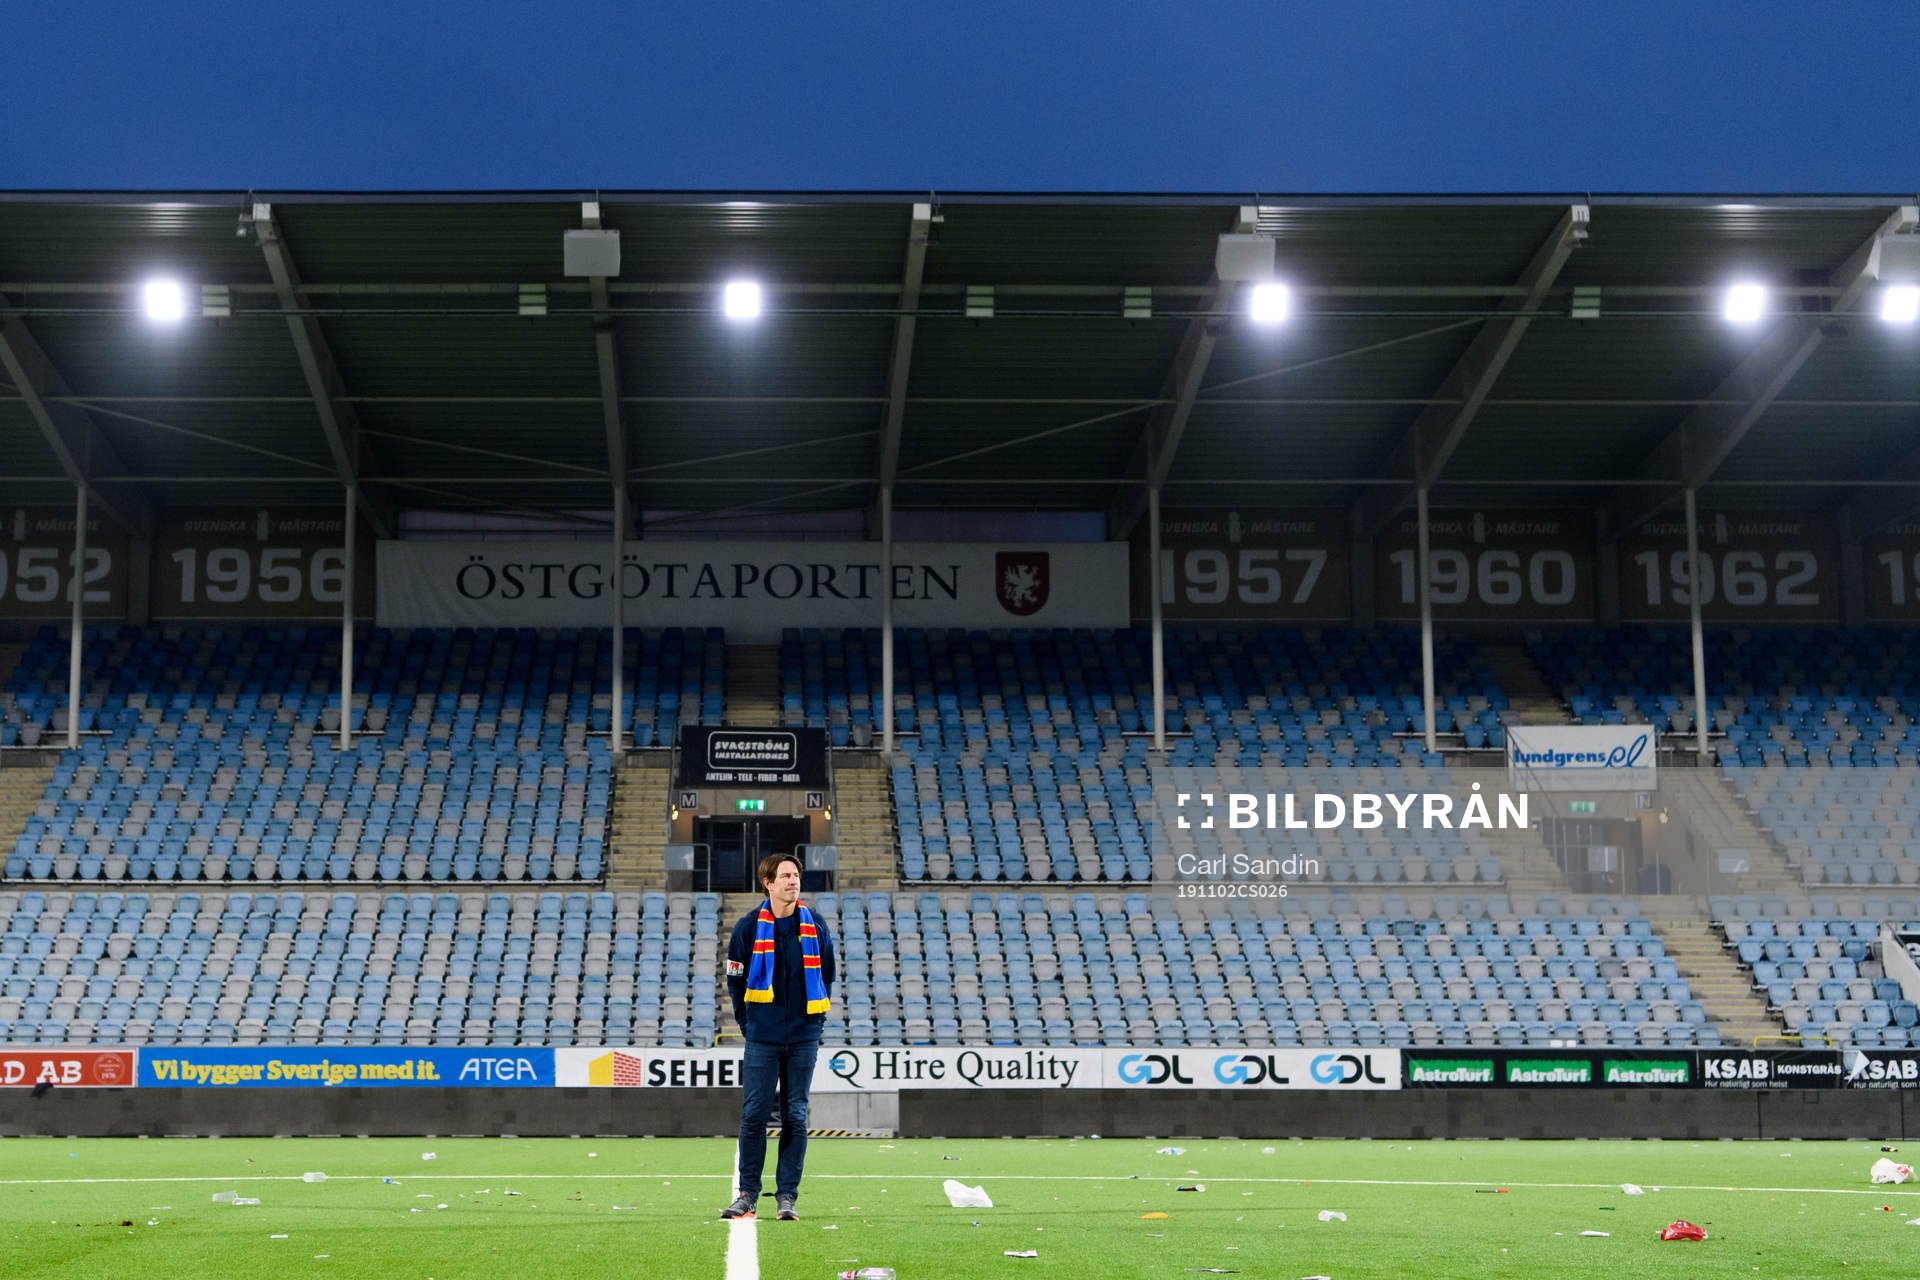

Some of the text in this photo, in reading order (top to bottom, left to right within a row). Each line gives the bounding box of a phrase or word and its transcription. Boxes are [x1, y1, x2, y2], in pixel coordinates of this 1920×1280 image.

[0, 547, 111, 602] 52
[171, 547, 346, 602] 1956
[456, 555, 960, 600] ÖSTGÖTAPORTEN
[1160, 549, 1327, 604] 1957
[1389, 549, 1576, 604] 1960
[1634, 549, 1820, 605] 1962
[738, 773, 753, 781] TELE
[682, 795, 695, 807] M
[808, 794, 821, 807] N
[36, 1061, 82, 1084] AB
[152, 1059, 440, 1084] Vi bygger Sverige med it.
[459, 1058, 537, 1080] ATEA
[648, 1059, 743, 1087] SEHE
[873, 1051, 945, 1080] Hire
[957, 1051, 1079, 1088] Quality
[1118, 1054, 1193, 1084] GDL
[1213, 1055, 1289, 1084] GDL
[1310, 1055, 1386, 1084] GDL
[1705, 1059, 1769, 1079] KSAB
